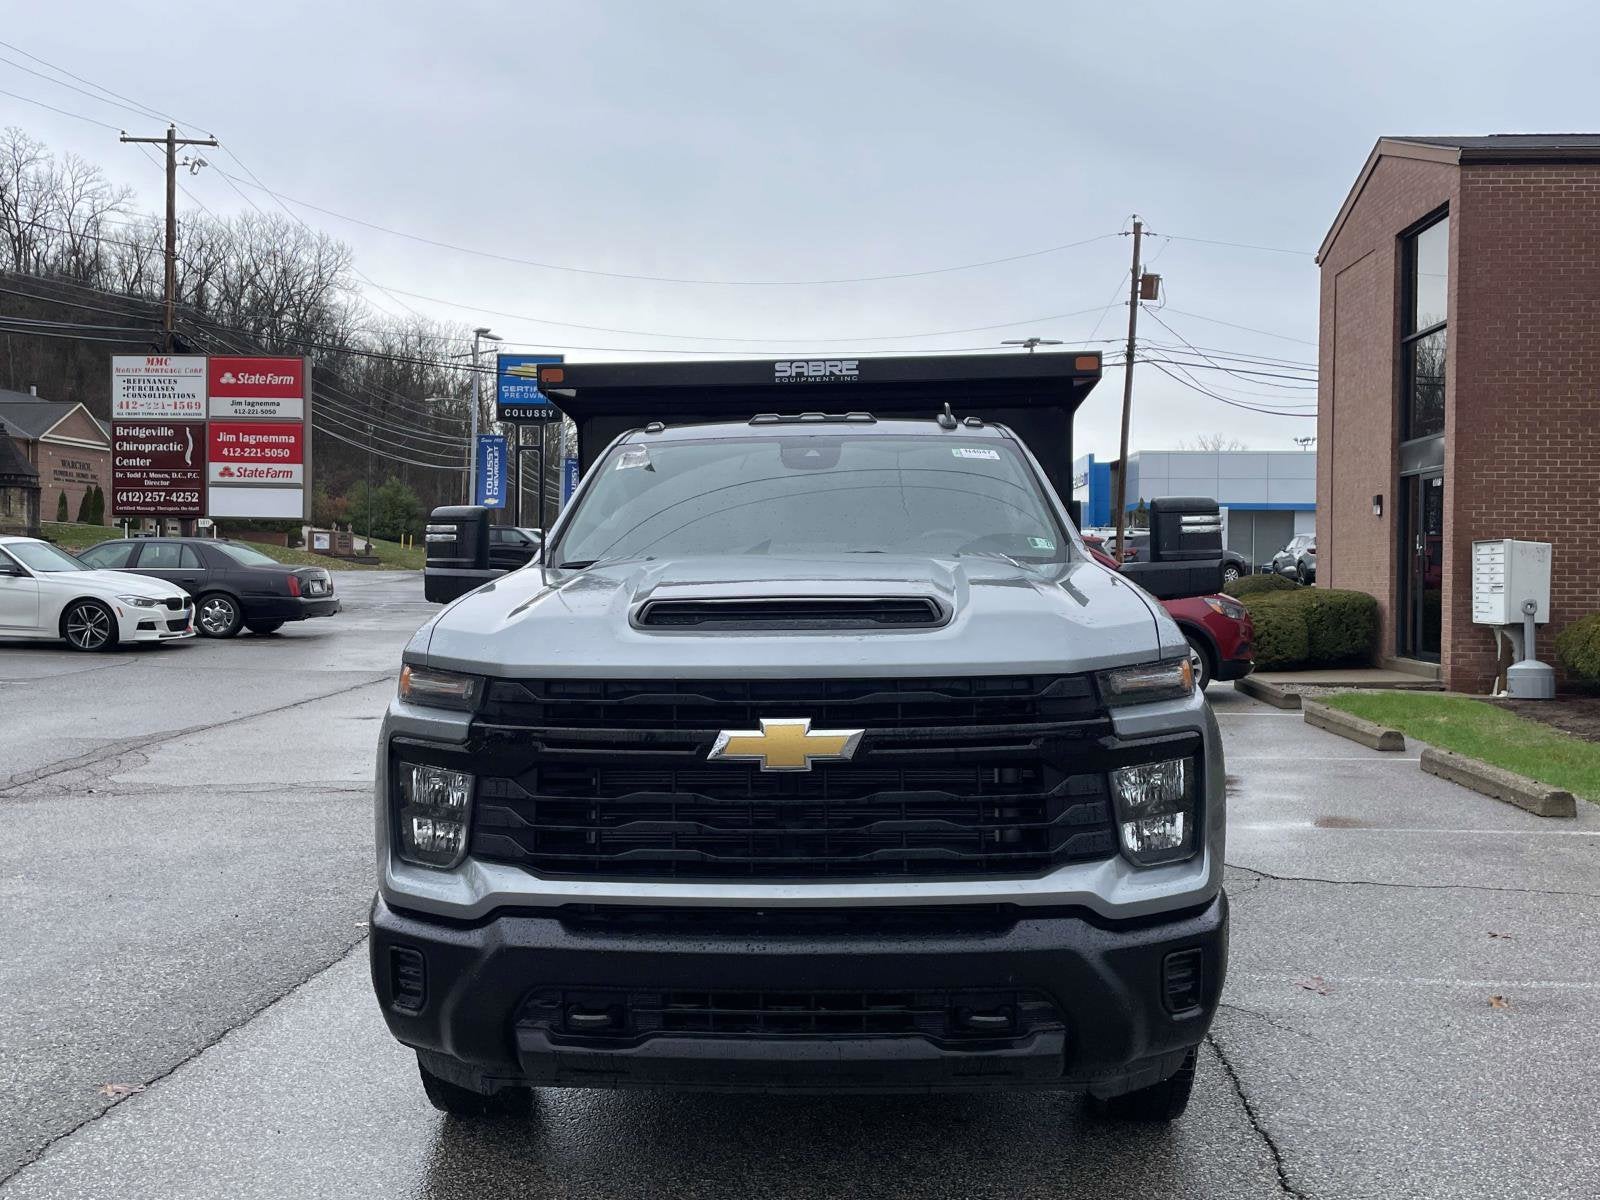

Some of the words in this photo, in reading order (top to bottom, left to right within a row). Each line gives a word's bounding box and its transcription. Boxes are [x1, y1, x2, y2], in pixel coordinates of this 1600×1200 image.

[145, 357, 171, 366] MMC
[774, 360, 859, 376] SABRE
[117, 400, 202, 411] 412-221-1569
[244, 400, 280, 408] Iagnemma
[504, 409, 554, 418] COLUSSY
[116, 426, 175, 439] Bridgeville
[217, 432, 236, 442] Jim
[239, 432, 295, 445] Iagnemma
[115, 441, 184, 453] Chiropractic
[222, 447, 290, 458] 412-221-5050
[115, 456, 152, 467] Center
[485, 445, 494, 496] COLUSSY
[144, 479, 170, 487] Director
[117, 491, 144, 503] (412)
[145, 491, 199, 503] 257-4252
